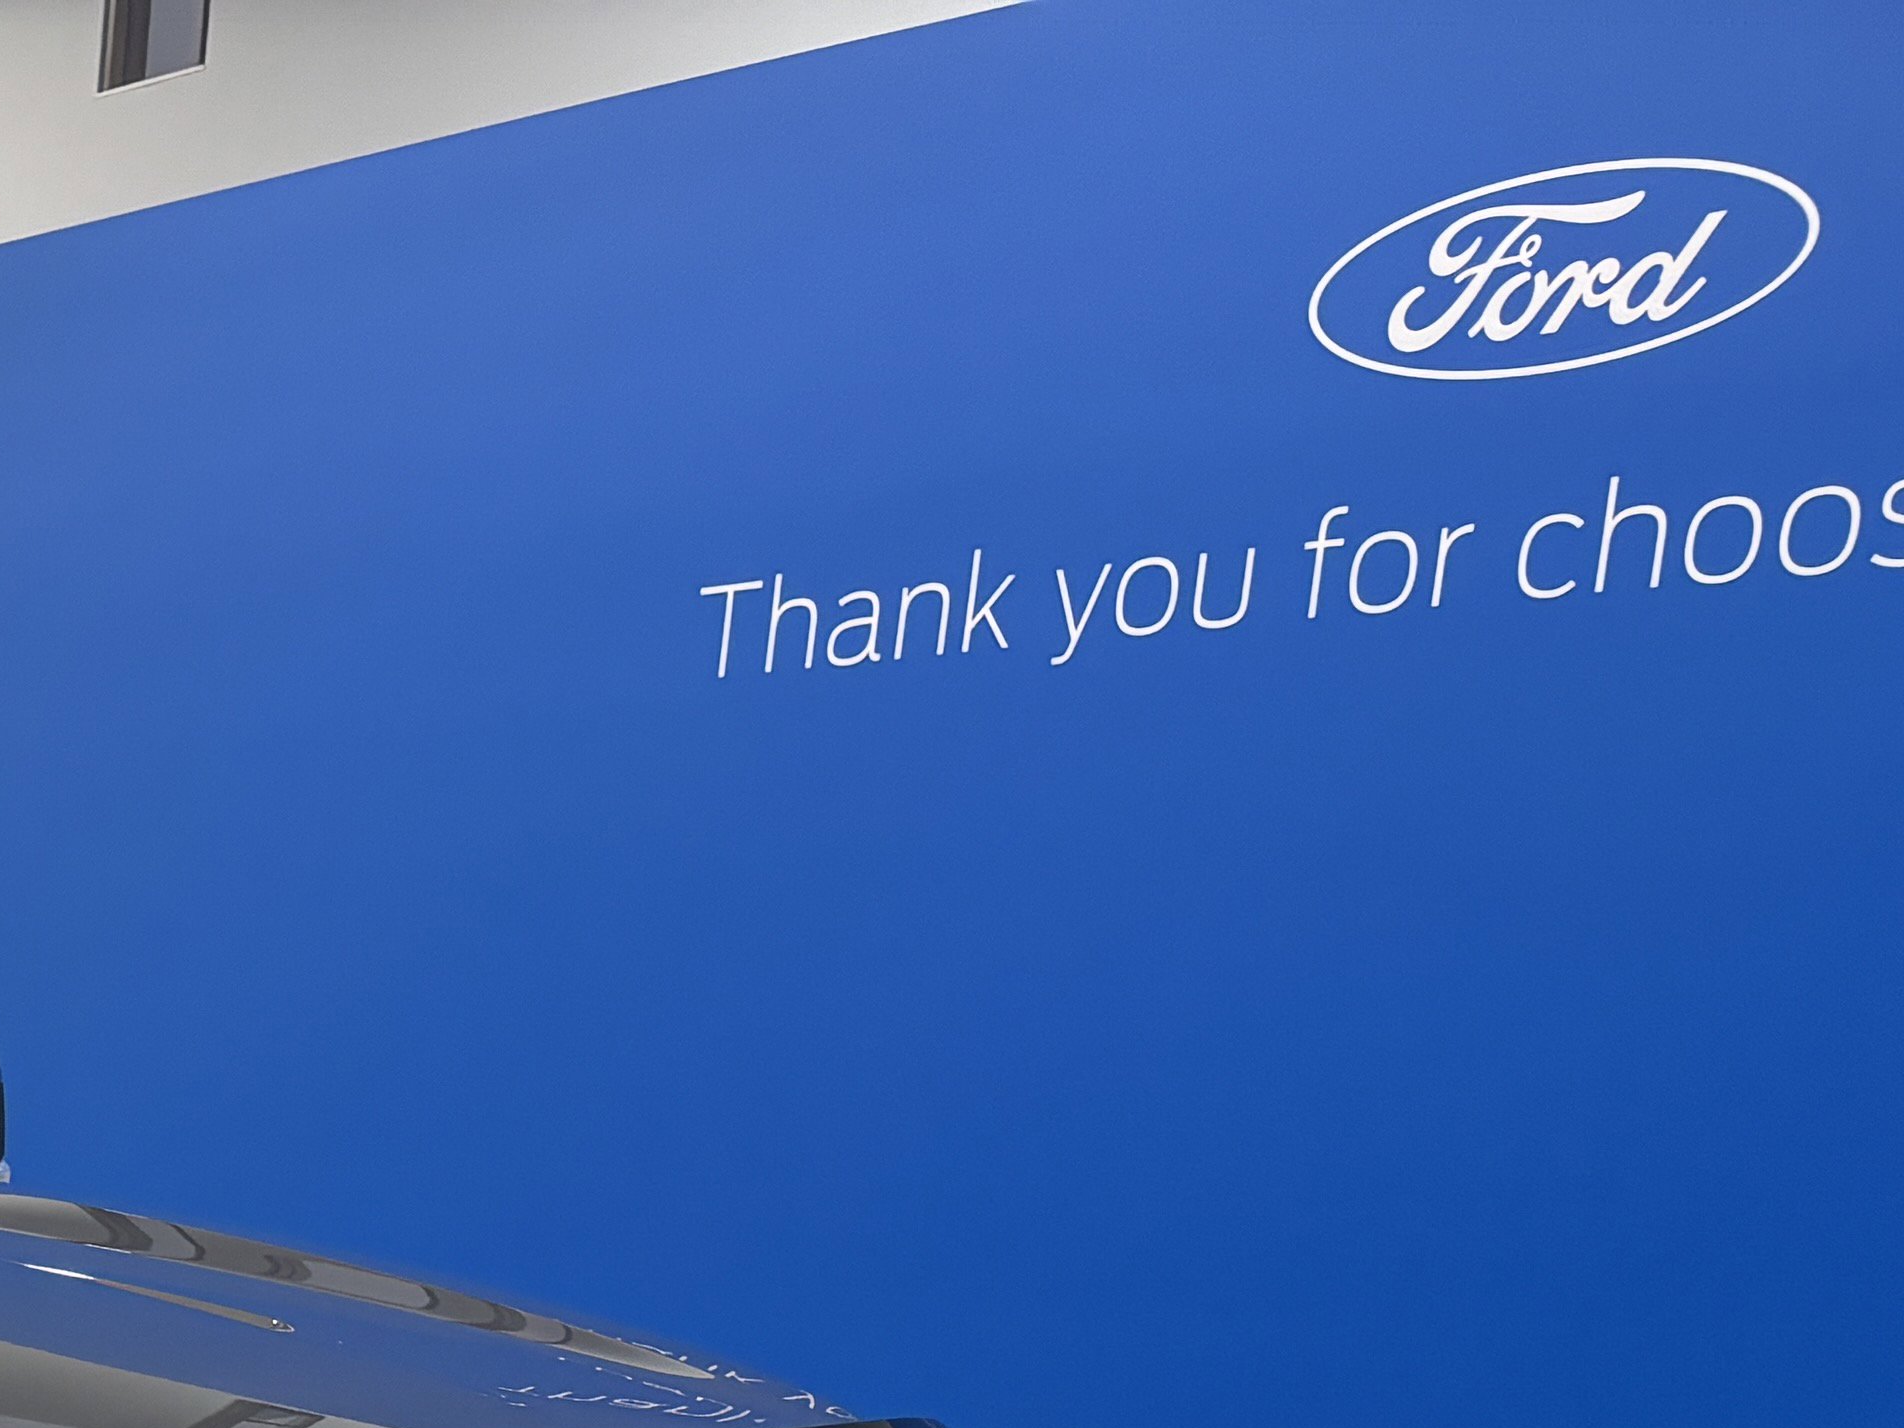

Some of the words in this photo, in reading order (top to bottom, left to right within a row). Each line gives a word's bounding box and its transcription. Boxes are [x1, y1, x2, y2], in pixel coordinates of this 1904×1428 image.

[1388, 190, 1728, 352] Ford
[699, 547, 1016, 679] Thank
[1049, 547, 1257, 667] you
[1303, 504, 1476, 620] for
